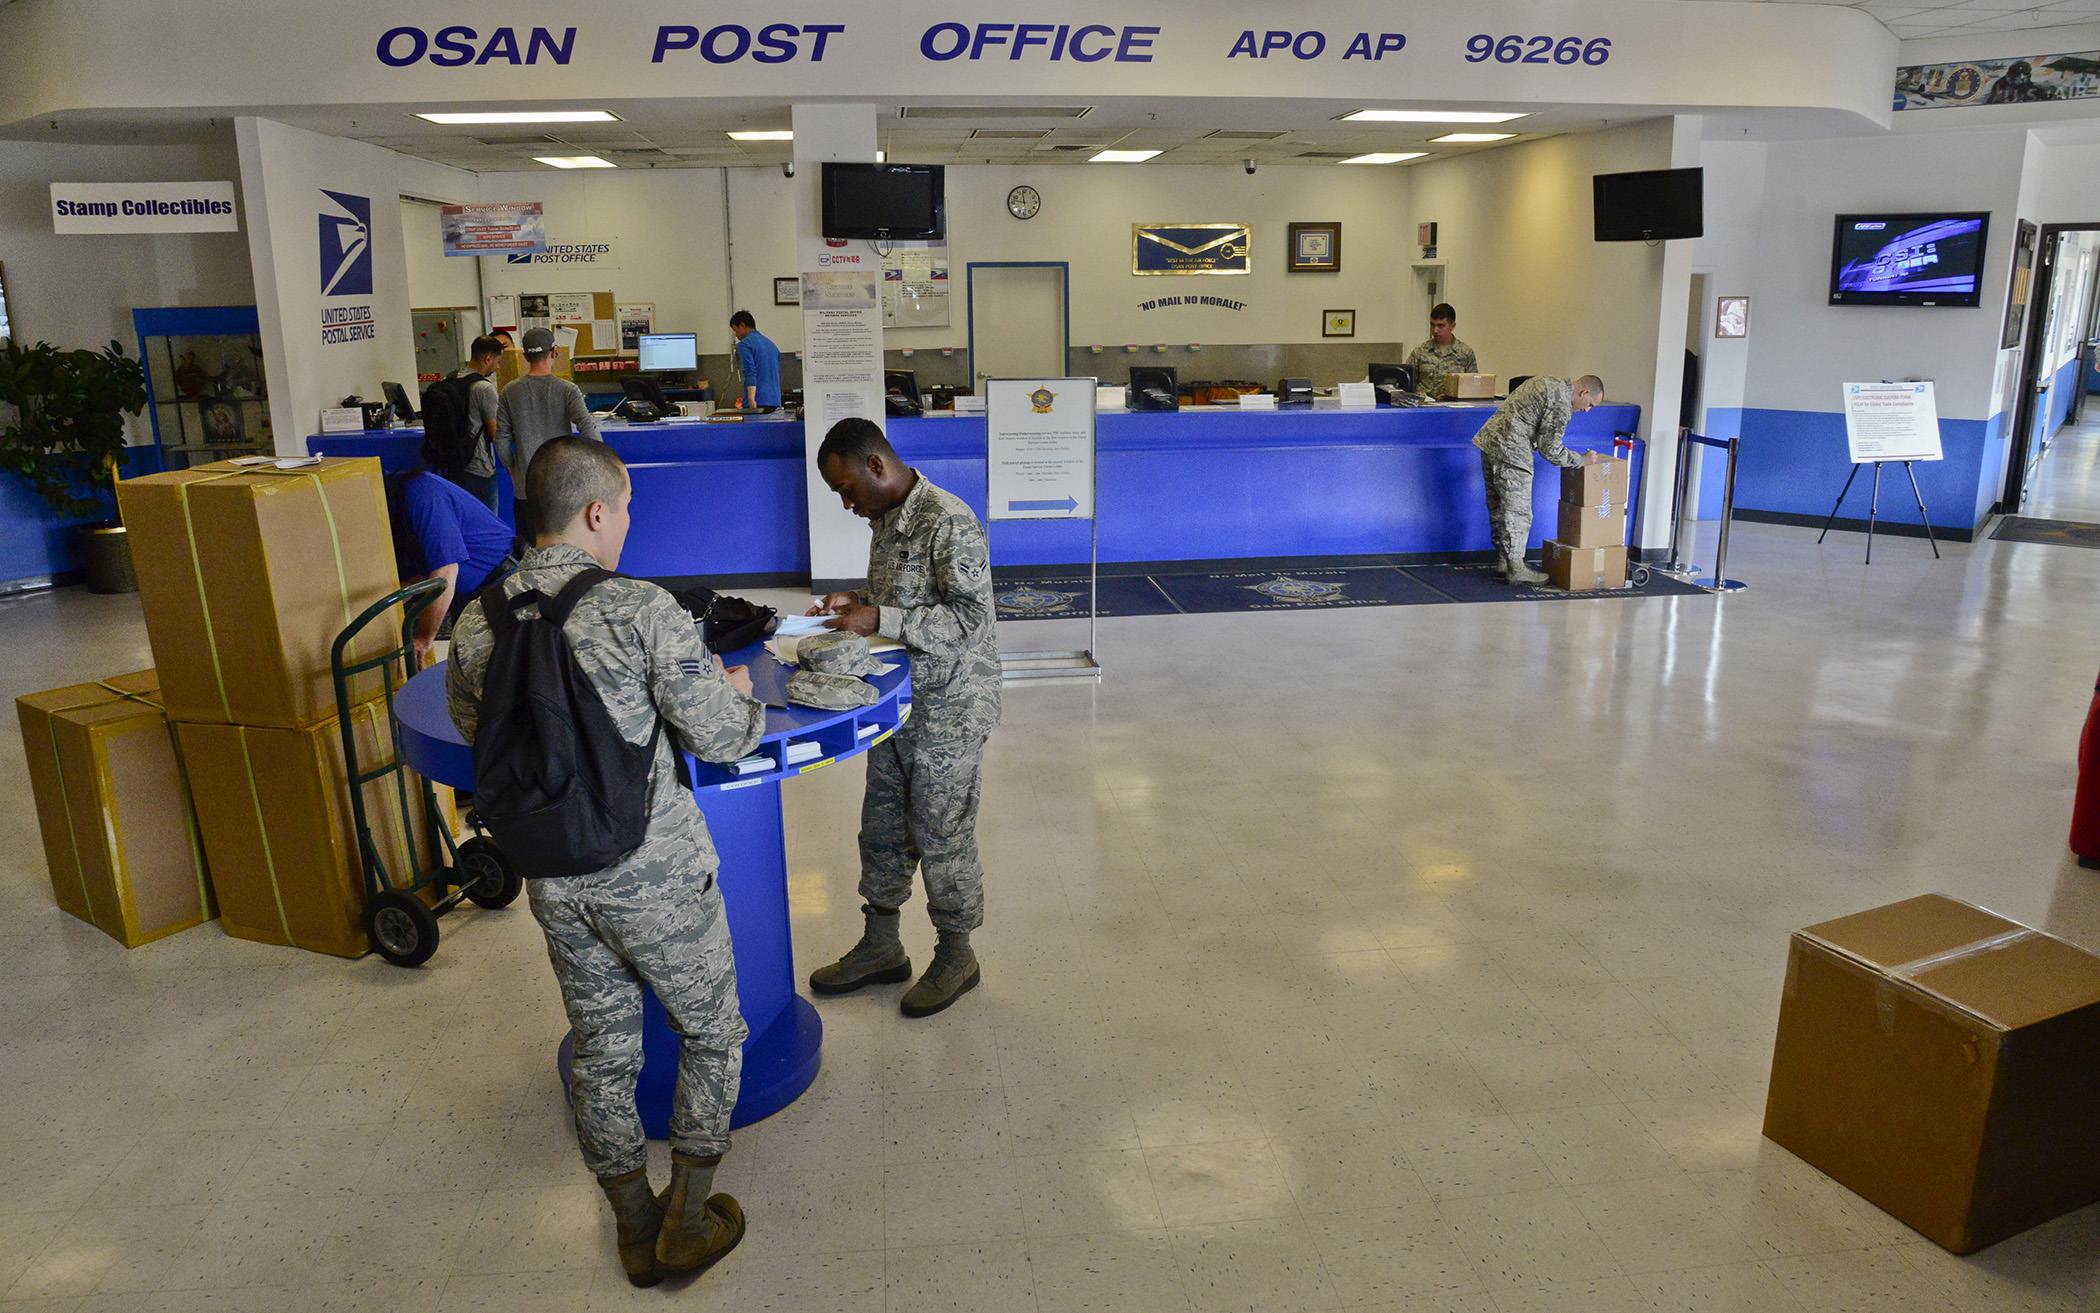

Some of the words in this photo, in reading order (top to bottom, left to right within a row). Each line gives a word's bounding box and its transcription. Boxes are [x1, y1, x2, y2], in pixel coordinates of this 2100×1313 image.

[376, 26, 577, 67] OSAN
[651, 24, 845, 64] POST
[919, 21, 1161, 62] OFFICE
[1228, 30, 1325, 60] APO
[1342, 32, 1408, 61] AP
[1464, 33, 1612, 66] 96266
[57, 200, 117, 217] Stamp
[122, 198, 232, 216] Collectibles
[534, 254, 561, 263] POST
[561, 253, 596, 263] OFFICE
[579, 244, 609, 253] STATES
[1874, 243, 1937, 266] CSI:
[1872, 254, 1939, 274] CYBER
[1868, 274, 1898, 282] TONIGHT
[1137, 300, 1156, 312] "NO
[1158, 296, 1182, 307] MAIL
[1184, 296, 1198, 304] NO
[1200, 296, 1247, 312] MORALE!"
[321, 307, 348, 324] UNITED
[348, 305, 371, 322] STATES
[322, 327, 348, 345] POSTAL
[349, 324, 374, 341] SERVICE
[903, 564, 924, 573] FORCE
